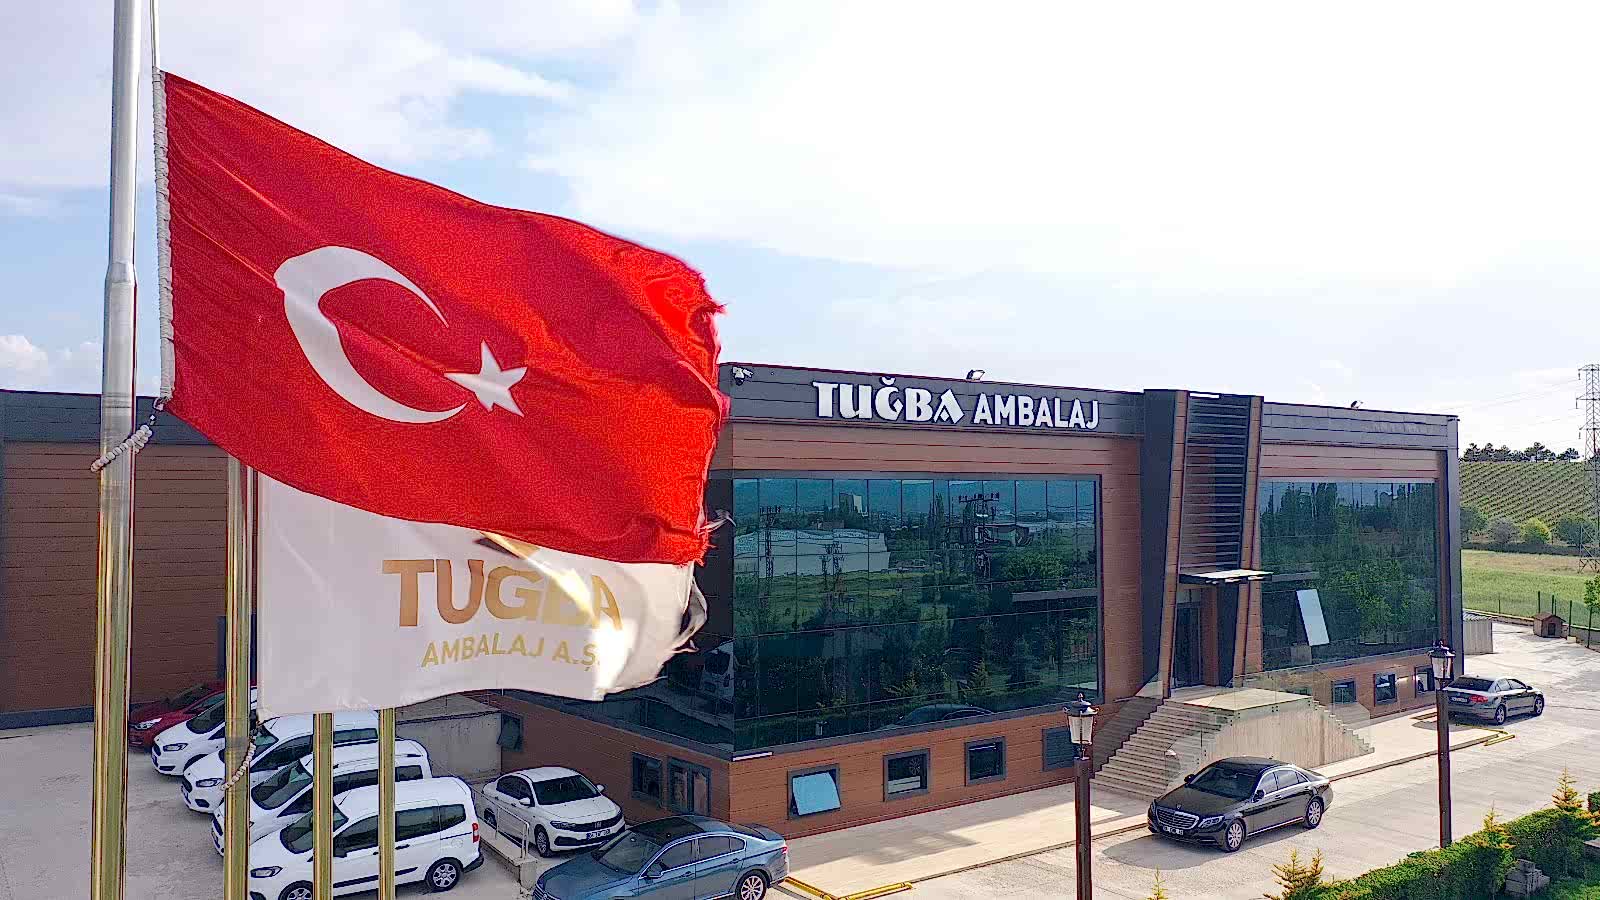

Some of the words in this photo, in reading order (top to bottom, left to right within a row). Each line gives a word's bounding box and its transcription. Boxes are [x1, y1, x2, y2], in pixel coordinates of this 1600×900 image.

[812, 376, 965, 424] TUĞBA
[973, 393, 1100, 430] AMBALAJ
[421, 632, 545, 668] AMBALAJ
